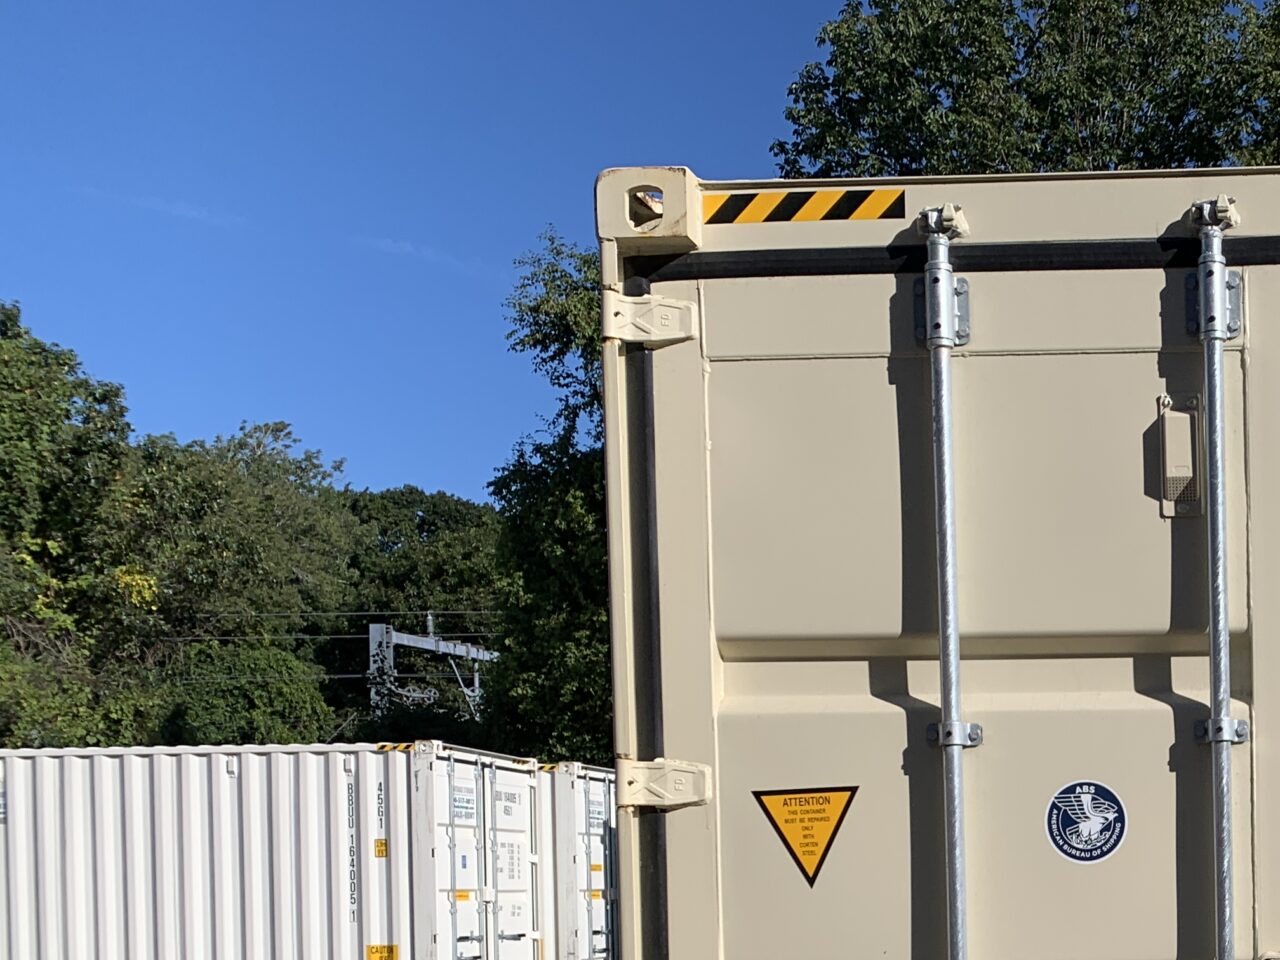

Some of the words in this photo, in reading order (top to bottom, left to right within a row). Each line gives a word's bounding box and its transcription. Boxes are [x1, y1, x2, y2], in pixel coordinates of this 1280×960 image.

[1075, 785, 1096, 794] ABS
[783, 796, 831, 807] ATTENTION
[1051, 808, 1064, 846] AMERICAN
[1063, 843, 1091, 857] BUREAU
[1092, 849, 1102, 857] OF
[1102, 822, 1121, 852] SHIPPING
